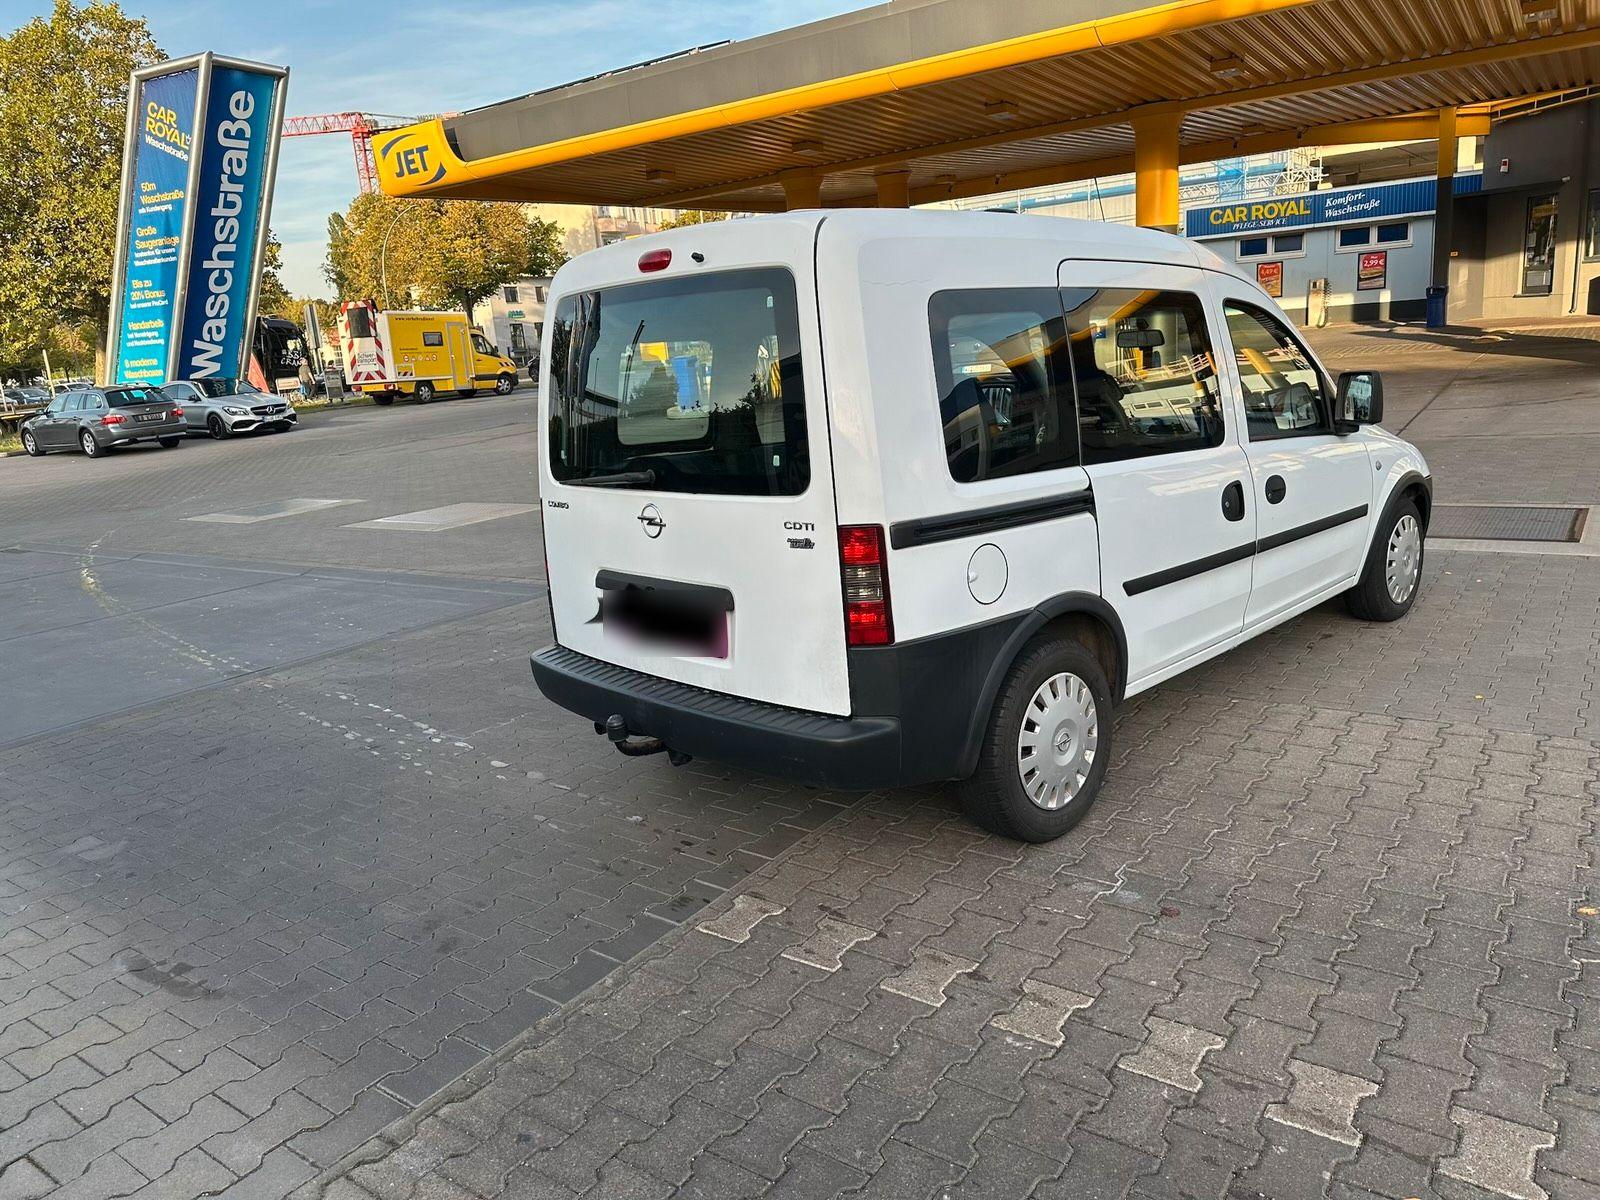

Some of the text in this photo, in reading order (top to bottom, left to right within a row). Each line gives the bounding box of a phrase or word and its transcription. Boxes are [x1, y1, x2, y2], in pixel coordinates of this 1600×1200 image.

[147, 101, 177, 128] CAR
[146, 116, 189, 150] ROYAL
[145, 133, 189, 162] Waschstraße
[395, 145, 429, 178] JET
[140, 189, 184, 204] Waschstraße
[1325, 192, 1365, 207] Komfort-
[1325, 199, 1380, 218] Waschstraße
[1209, 198, 1310, 225] CAR ROYAL
[189, 90, 255, 379] Waschstraße
[1363, 258, 1385, 268] 2,99 €
[784, 521, 815, 531] CDTI
